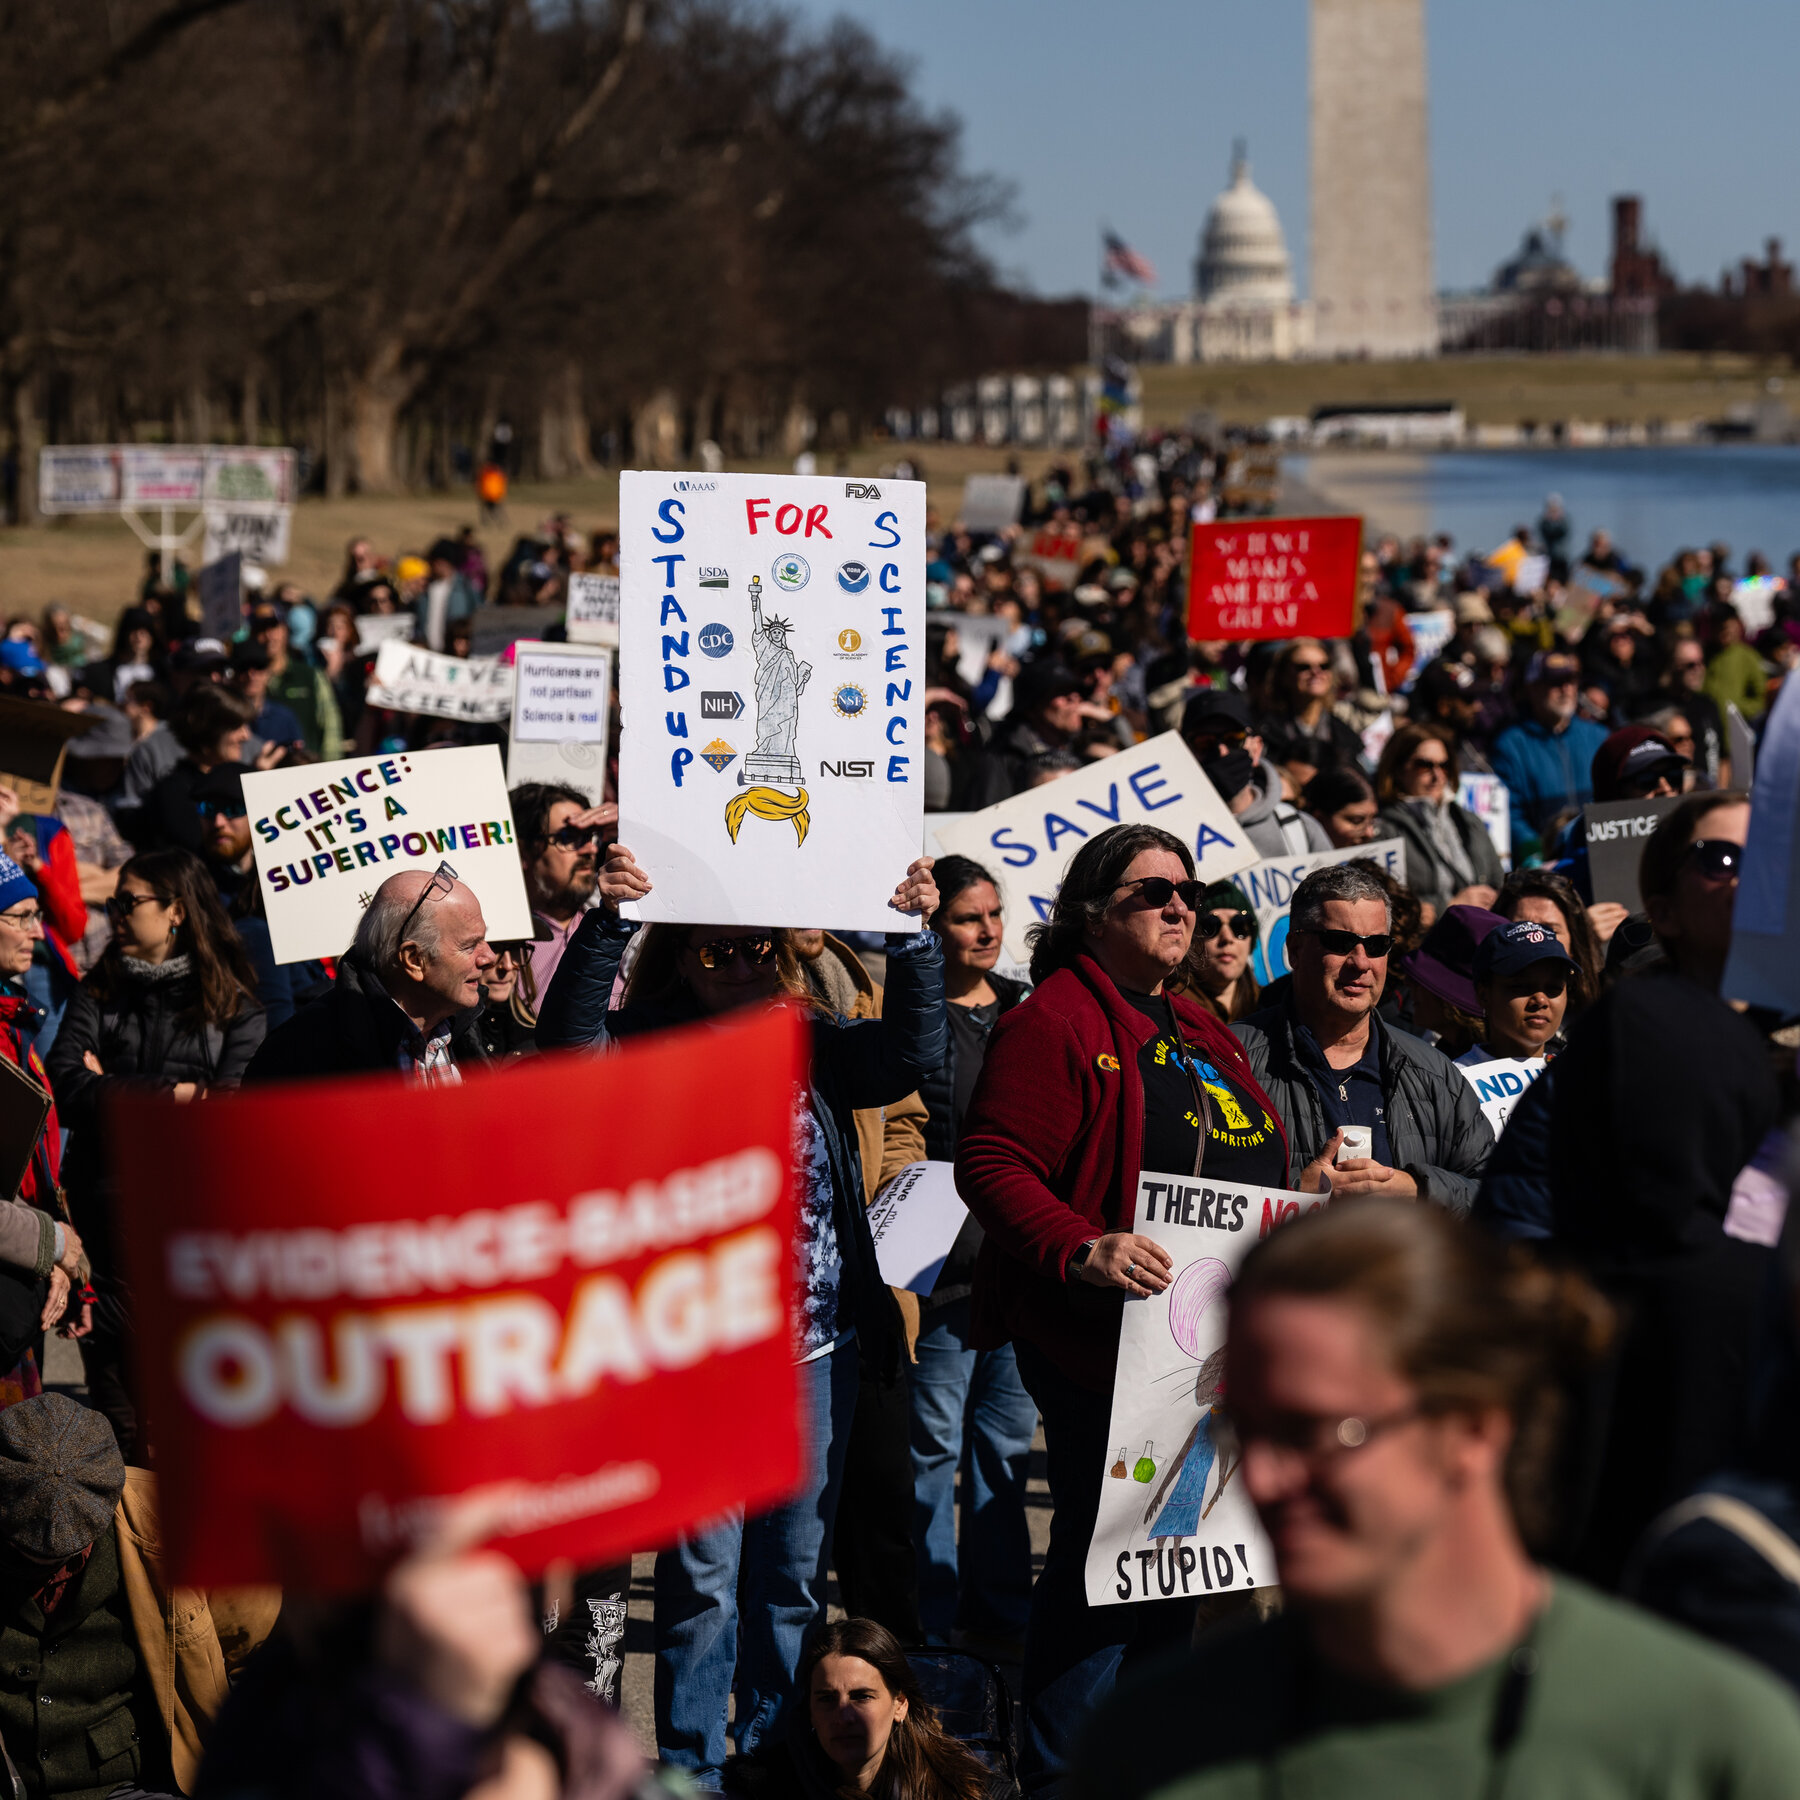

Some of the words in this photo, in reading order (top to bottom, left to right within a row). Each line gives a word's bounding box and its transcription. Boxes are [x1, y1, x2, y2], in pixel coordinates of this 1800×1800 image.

[845, 483, 882, 499] FDA
[745, 498, 833, 539] FOR
[699, 567, 729, 577] USDA
[700, 632, 733, 648] CDC
[868, 511, 912, 783] SCIENCE
[524, 664, 582, 678] Hurricanes
[584, 669, 600, 678] are
[530, 686, 547, 697] not
[549, 687, 592, 699] partisan
[704, 698, 733, 712] NIH
[837, 695, 863, 707] NSF
[522, 708, 563, 722] Science
[566, 710, 575, 721] is
[578, 711, 597, 722] real
[820, 760, 875, 777] NIST
[254, 755, 412, 843] SCIENCE:
[384, 796, 408, 822] A
[990, 763, 1184, 867] SAVE
[1586, 814, 1659, 842] JUSTICE
[880, 1168, 912, 1207] thanks
[897, 1173, 922, 1202] have
[167, 1147, 783, 1302] EVIDENCE-BASED
[871, 1208, 886, 1221] to
[178, 1226, 783, 1428] OUTRAGE
[1116, 1544, 1254, 1600] STUPID!
